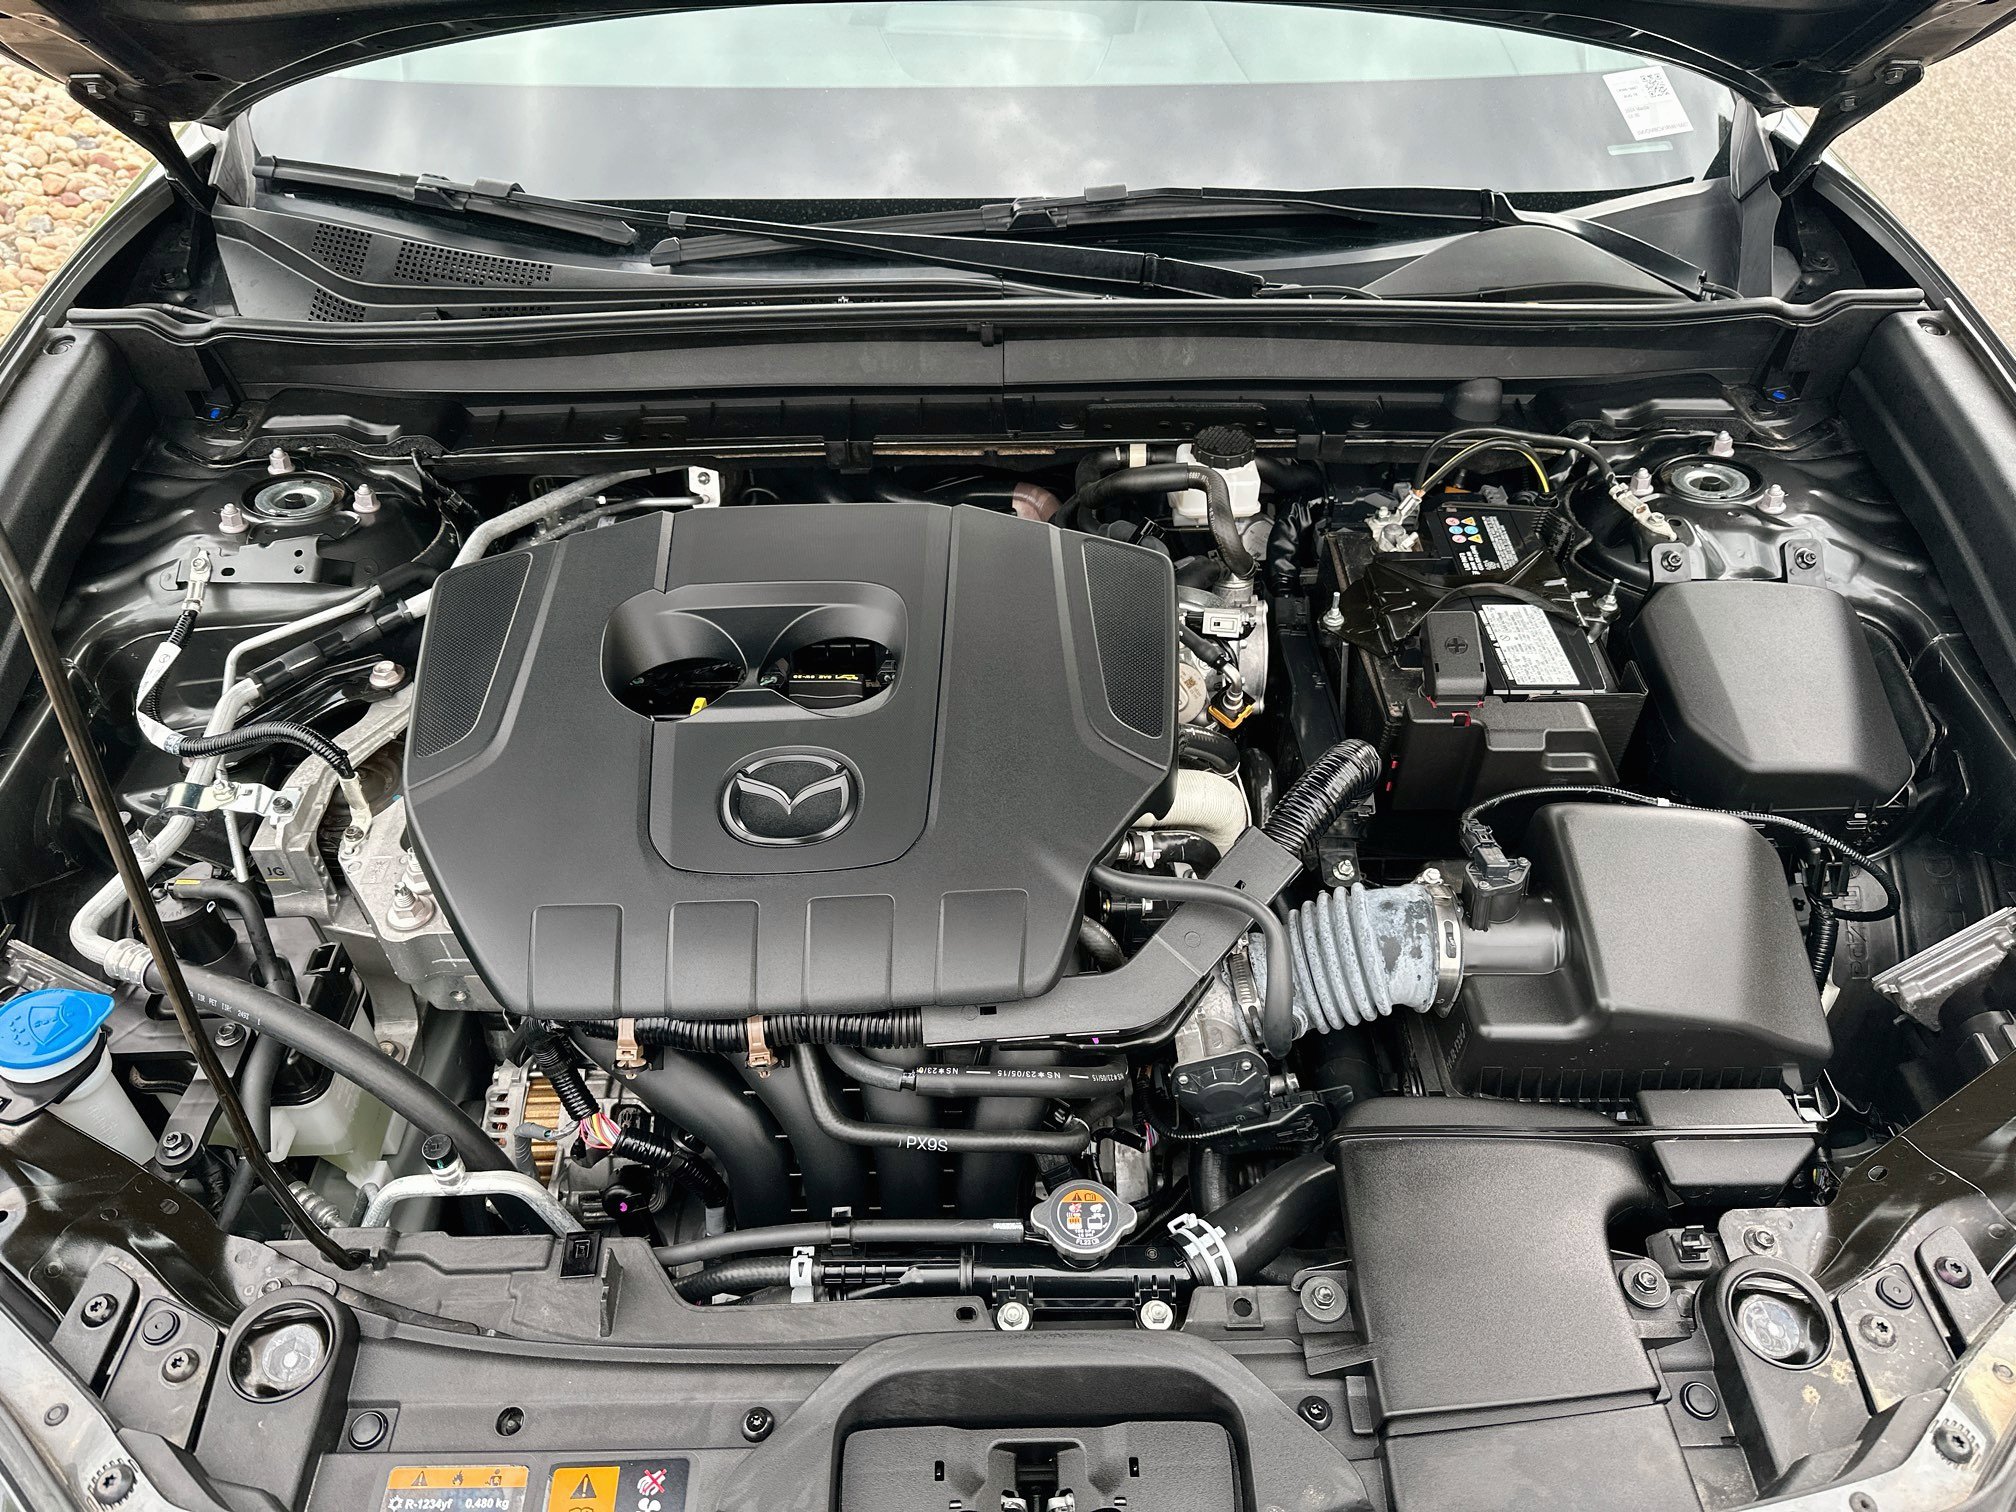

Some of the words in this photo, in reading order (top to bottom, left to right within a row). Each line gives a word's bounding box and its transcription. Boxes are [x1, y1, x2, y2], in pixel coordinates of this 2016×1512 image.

[906, 1135, 949, 1152] PX9S
[405, 1498, 453, 1511] R-1234yf
[465, 1498, 494, 1509] 0.480
[495, 1498, 510, 1510] kg
